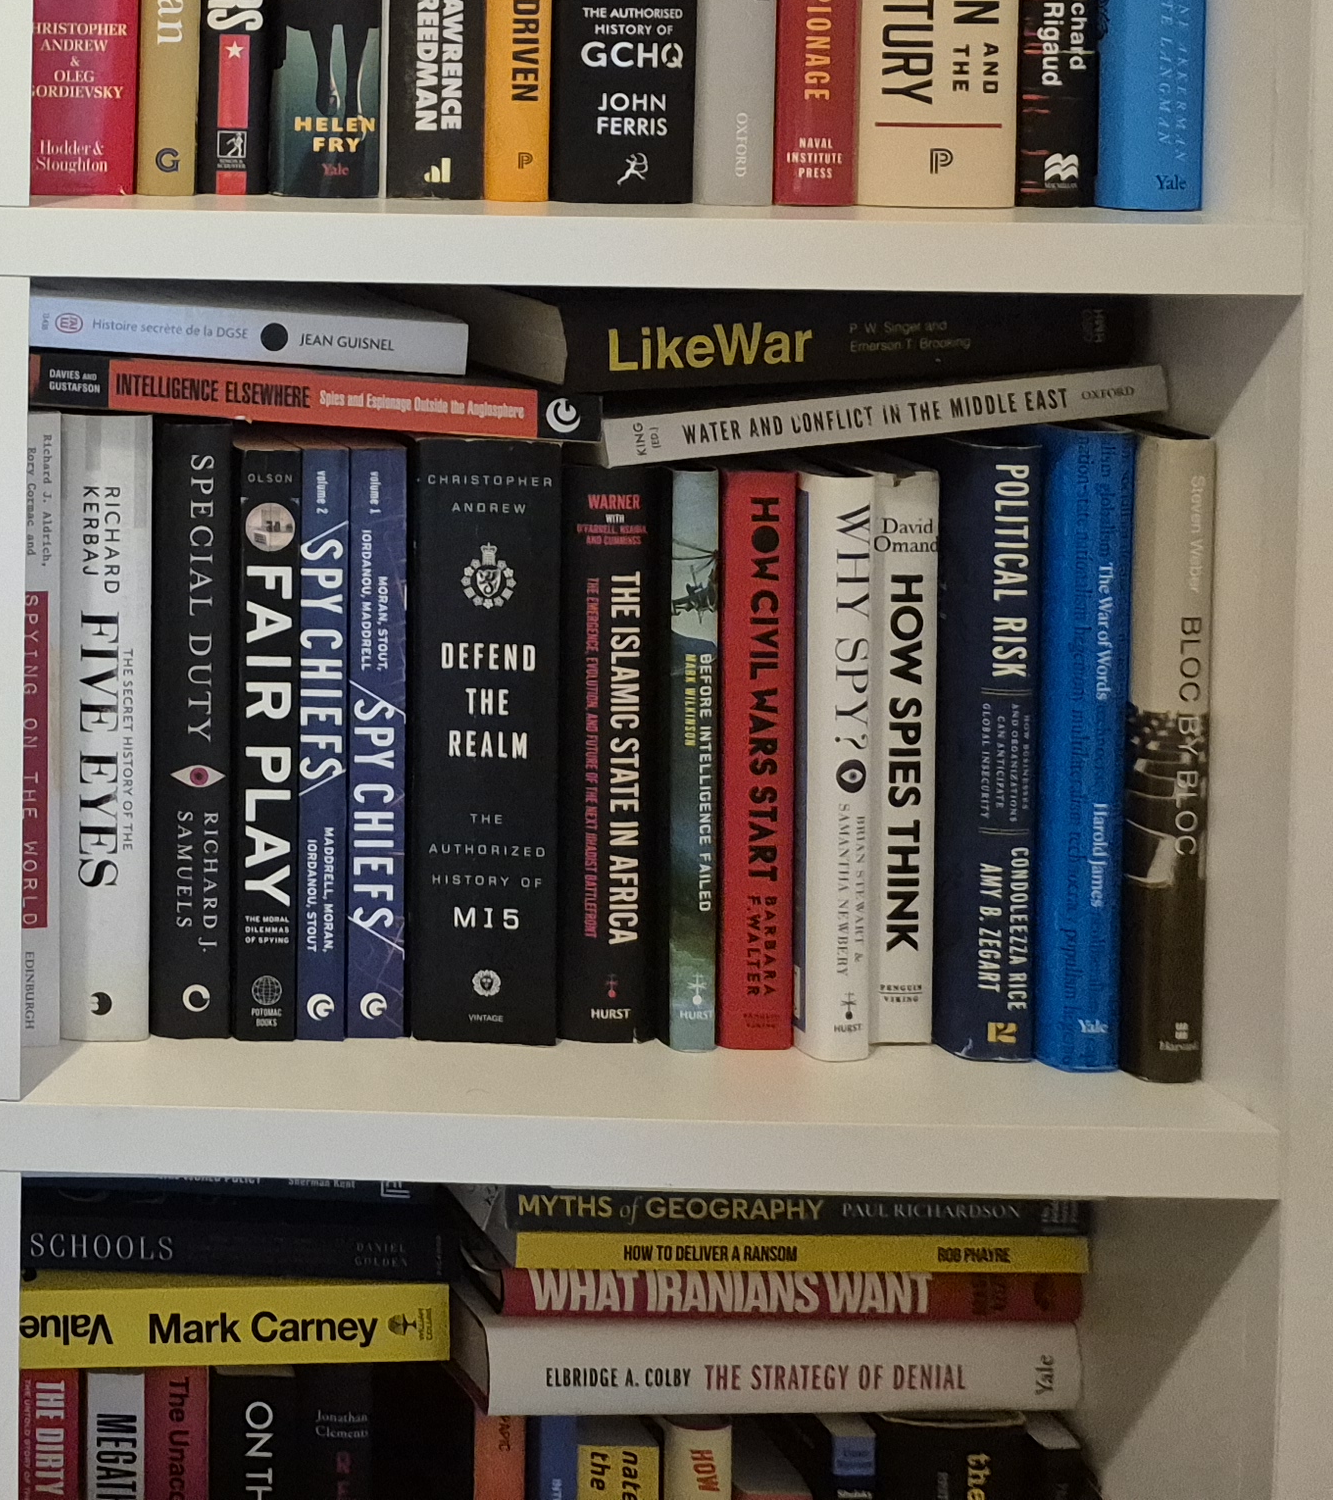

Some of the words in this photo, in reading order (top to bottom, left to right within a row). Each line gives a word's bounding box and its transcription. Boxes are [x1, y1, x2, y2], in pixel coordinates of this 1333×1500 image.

[581, 41, 683, 68] GCHQ
[598, 93, 666, 111] JOHN
[597, 117, 667, 136] FERRIS
[300, 334, 333, 346] JEAN
[337, 336, 394, 351] GUISNEL
[609, 322, 812, 371] LikeWar
[248, 473, 292, 483] OLSON
[882, 518, 933, 536] David
[874, 536, 939, 554] Omand
[442, 643, 535, 671] DEFEND
[466, 688, 508, 715] THE
[449, 730, 527, 759] REALM
[454, 907, 519, 929] MI5
[31, 1233, 172, 1259] SCHOOLS
[149, 1313, 240, 1344] Mark
[252, 1311, 377, 1347] Carney
[705, 1365, 741, 1390] THE
[751, 1365, 849, 1390] STRATEGY
[859, 1365, 882, 1390] OF
[893, 1365, 965, 1390] DENIAL
